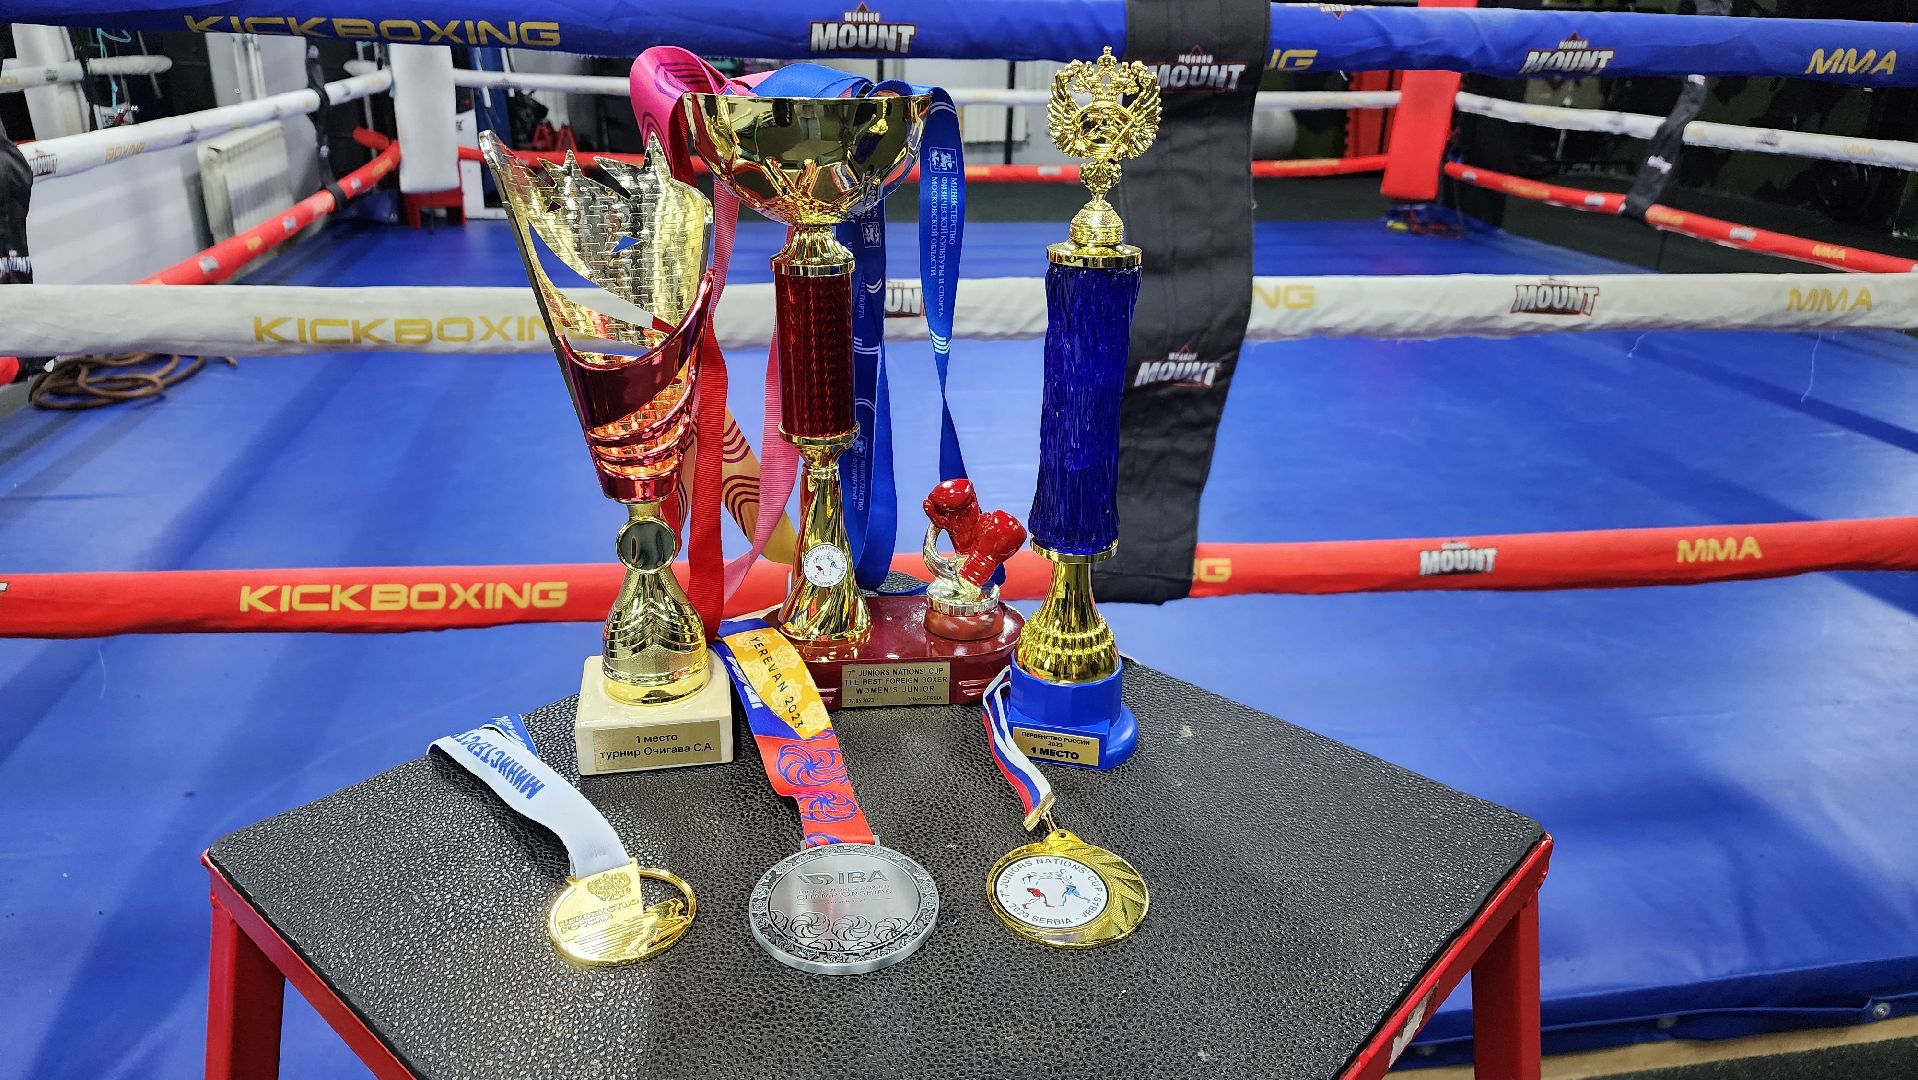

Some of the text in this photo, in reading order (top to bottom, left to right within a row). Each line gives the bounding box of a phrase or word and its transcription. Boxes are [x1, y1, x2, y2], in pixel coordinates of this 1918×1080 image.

[183, 14, 560, 47] KICKBOXING
[811, 22, 915, 53] MOUNT
[1519, 50, 1614, 74] MOUNT
[1804, 47, 1897, 75] MMA
[1148, 63, 1246, 90] MOUNT
[949, 177, 958, 245] МИНИСТЕРСТВО
[1511, 286, 1599, 316] MOUNT
[1788, 287, 1873, 312] MMA
[1134, 362, 1220, 387] MOUNT
[1419, 547, 1497, 576] MOUNT
[1677, 536, 1762, 563] MMA
[239, 581, 569, 613] KICKBOXING
[750, 636, 803, 729] YEREVAN 2023
[859, 669, 890, 677] JUNIORS
[886, 677, 919, 685] FOREIGN
[902, 685, 935, 693] JUNIOR
[600, 742, 715, 760] турнир Очигава С.А.
[643, 734, 678, 743] место
[1021, 731, 1090, 745] ПЕРВЕНСТВО РОССИИ
[1040, 748, 1079, 760] МЕСТО
[838, 868, 890, 884] IBA
[1000, 859, 1033, 889] JUNIORS
[1087, 874, 1103, 893] CUP
[1008, 897, 1102, 926] 2023 SERBIA VRBAS
